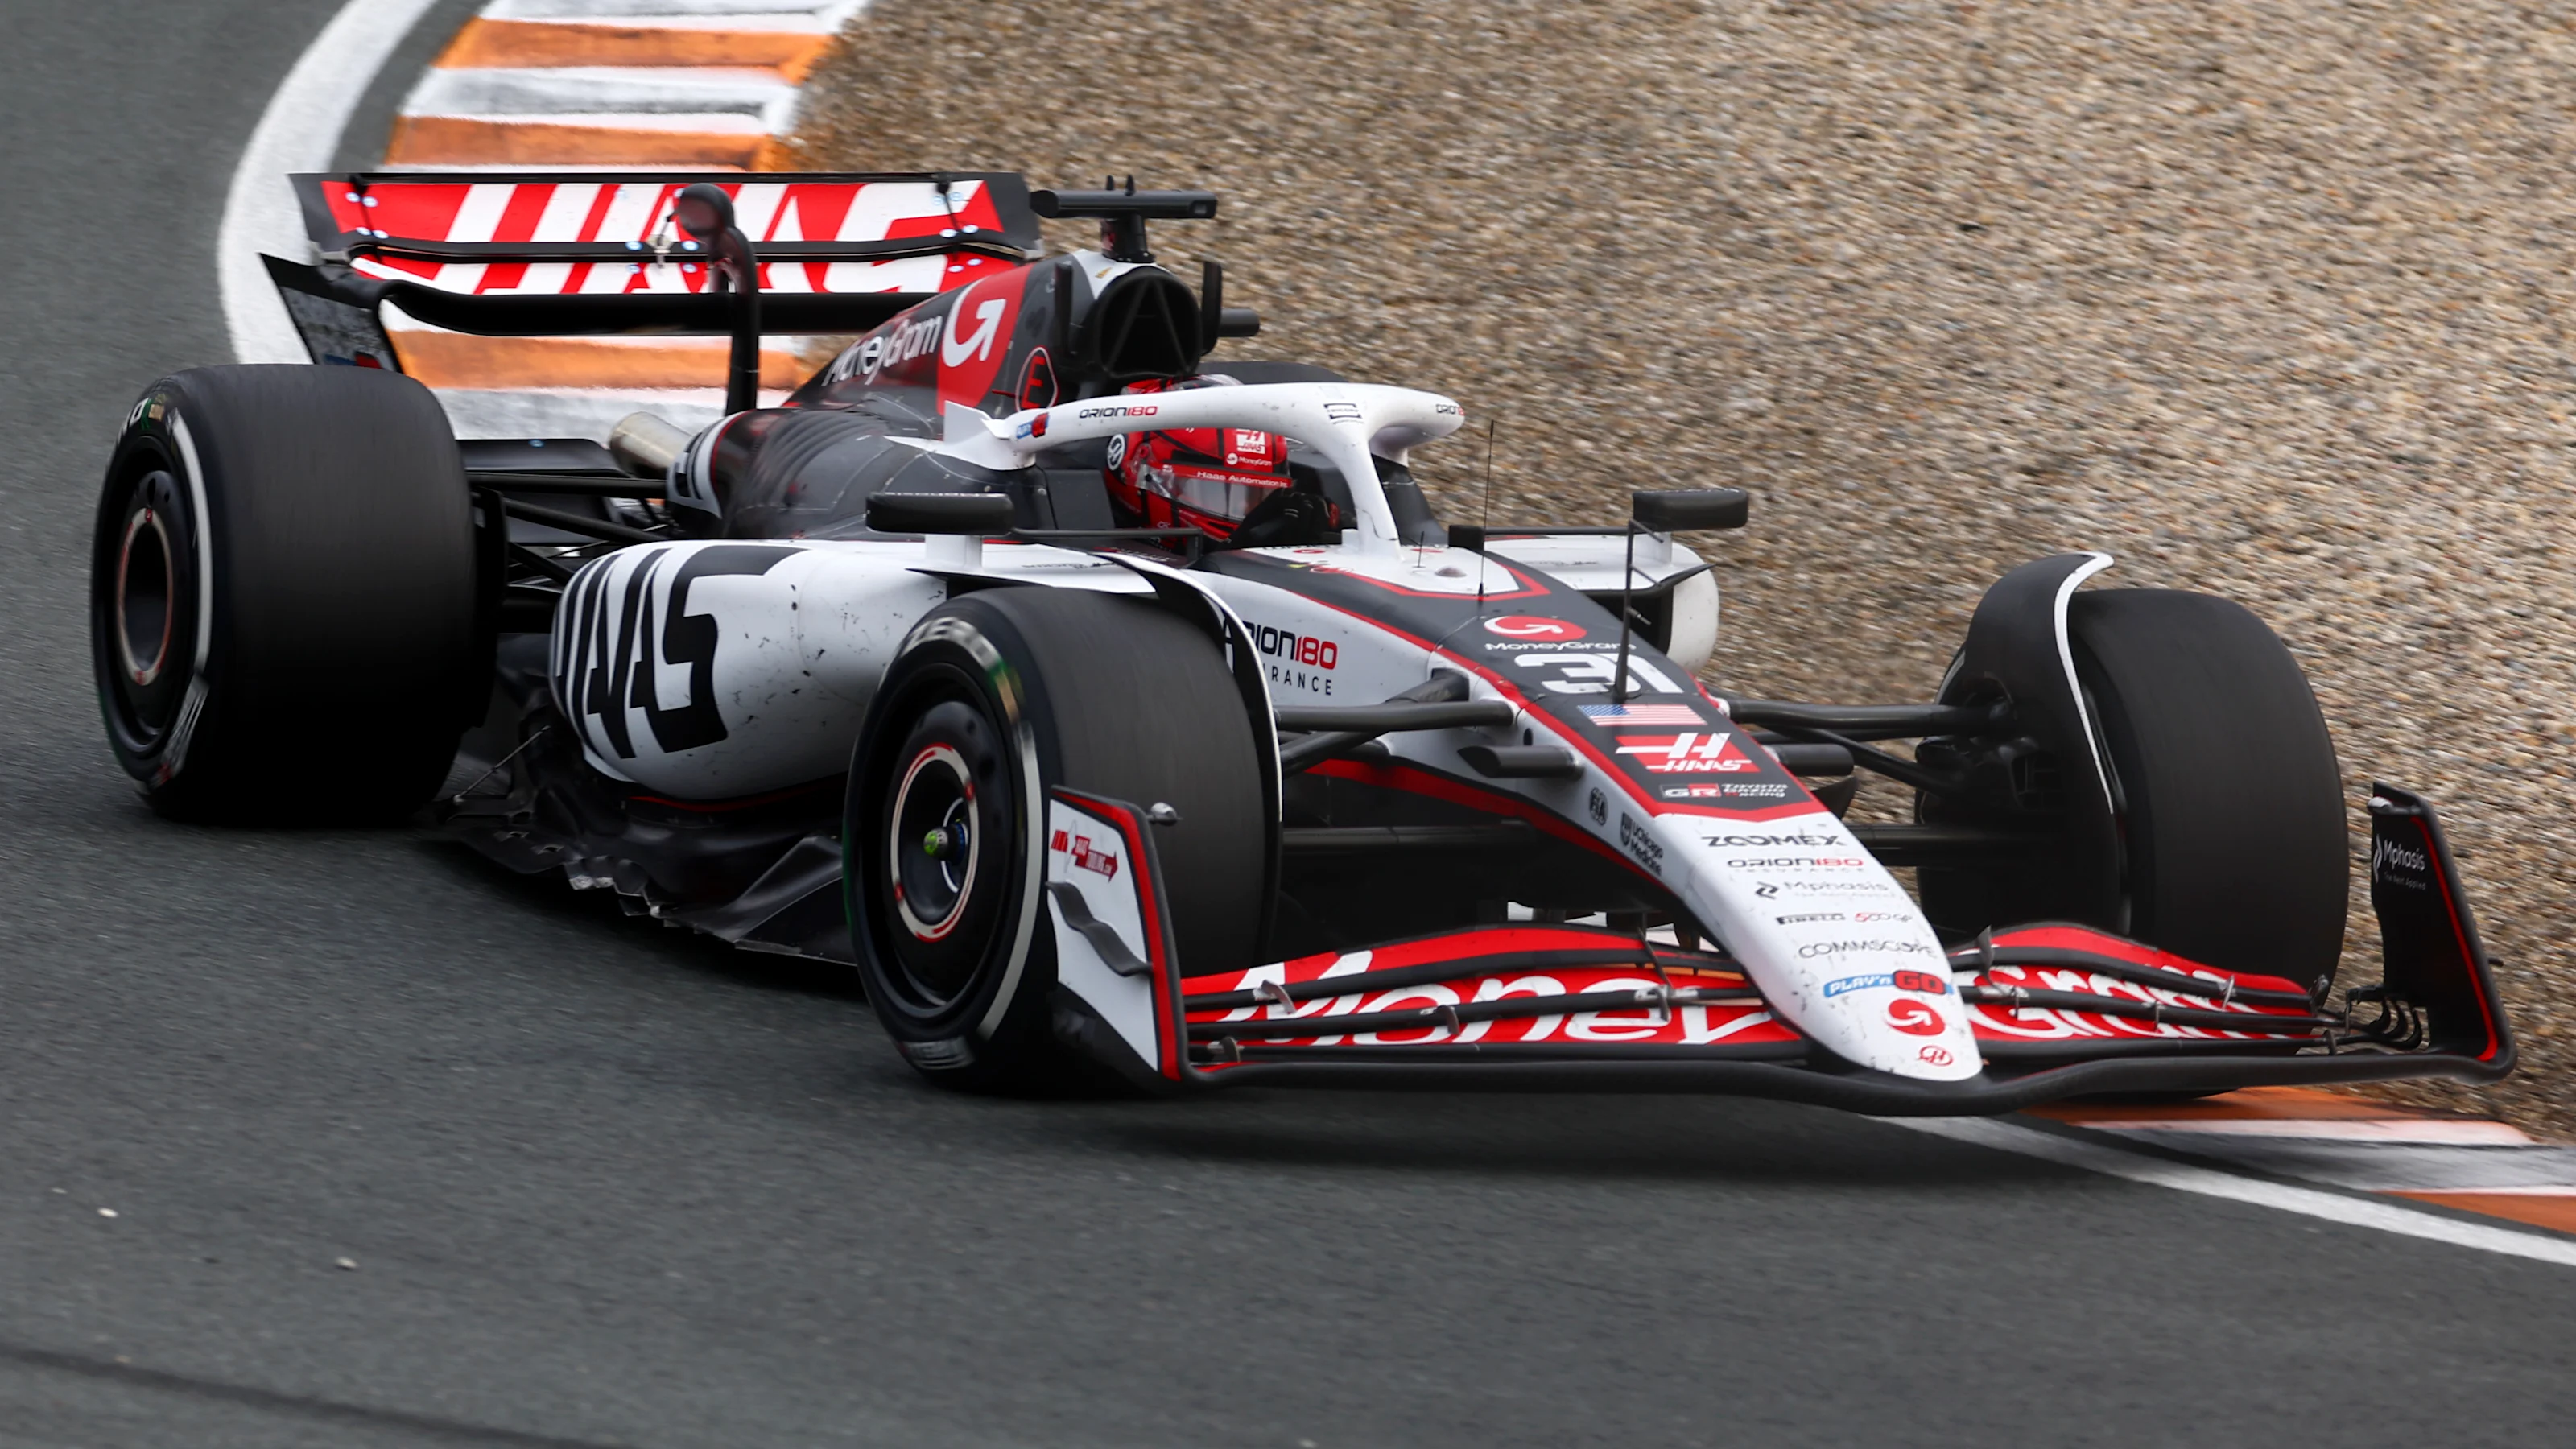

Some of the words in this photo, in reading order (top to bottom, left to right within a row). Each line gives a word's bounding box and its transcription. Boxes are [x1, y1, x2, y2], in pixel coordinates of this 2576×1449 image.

[1079, 405, 1158, 419] ORION180
[1196, 471, 1225, 481] Haas
[1228, 474, 1279, 486] Automation
[1514, 653, 1684, 694] 31
[1701, 835, 1844, 847] ZOOMEX
[1727, 857, 1864, 868] ORION180
[2383, 839, 2425, 872] Mphasis
